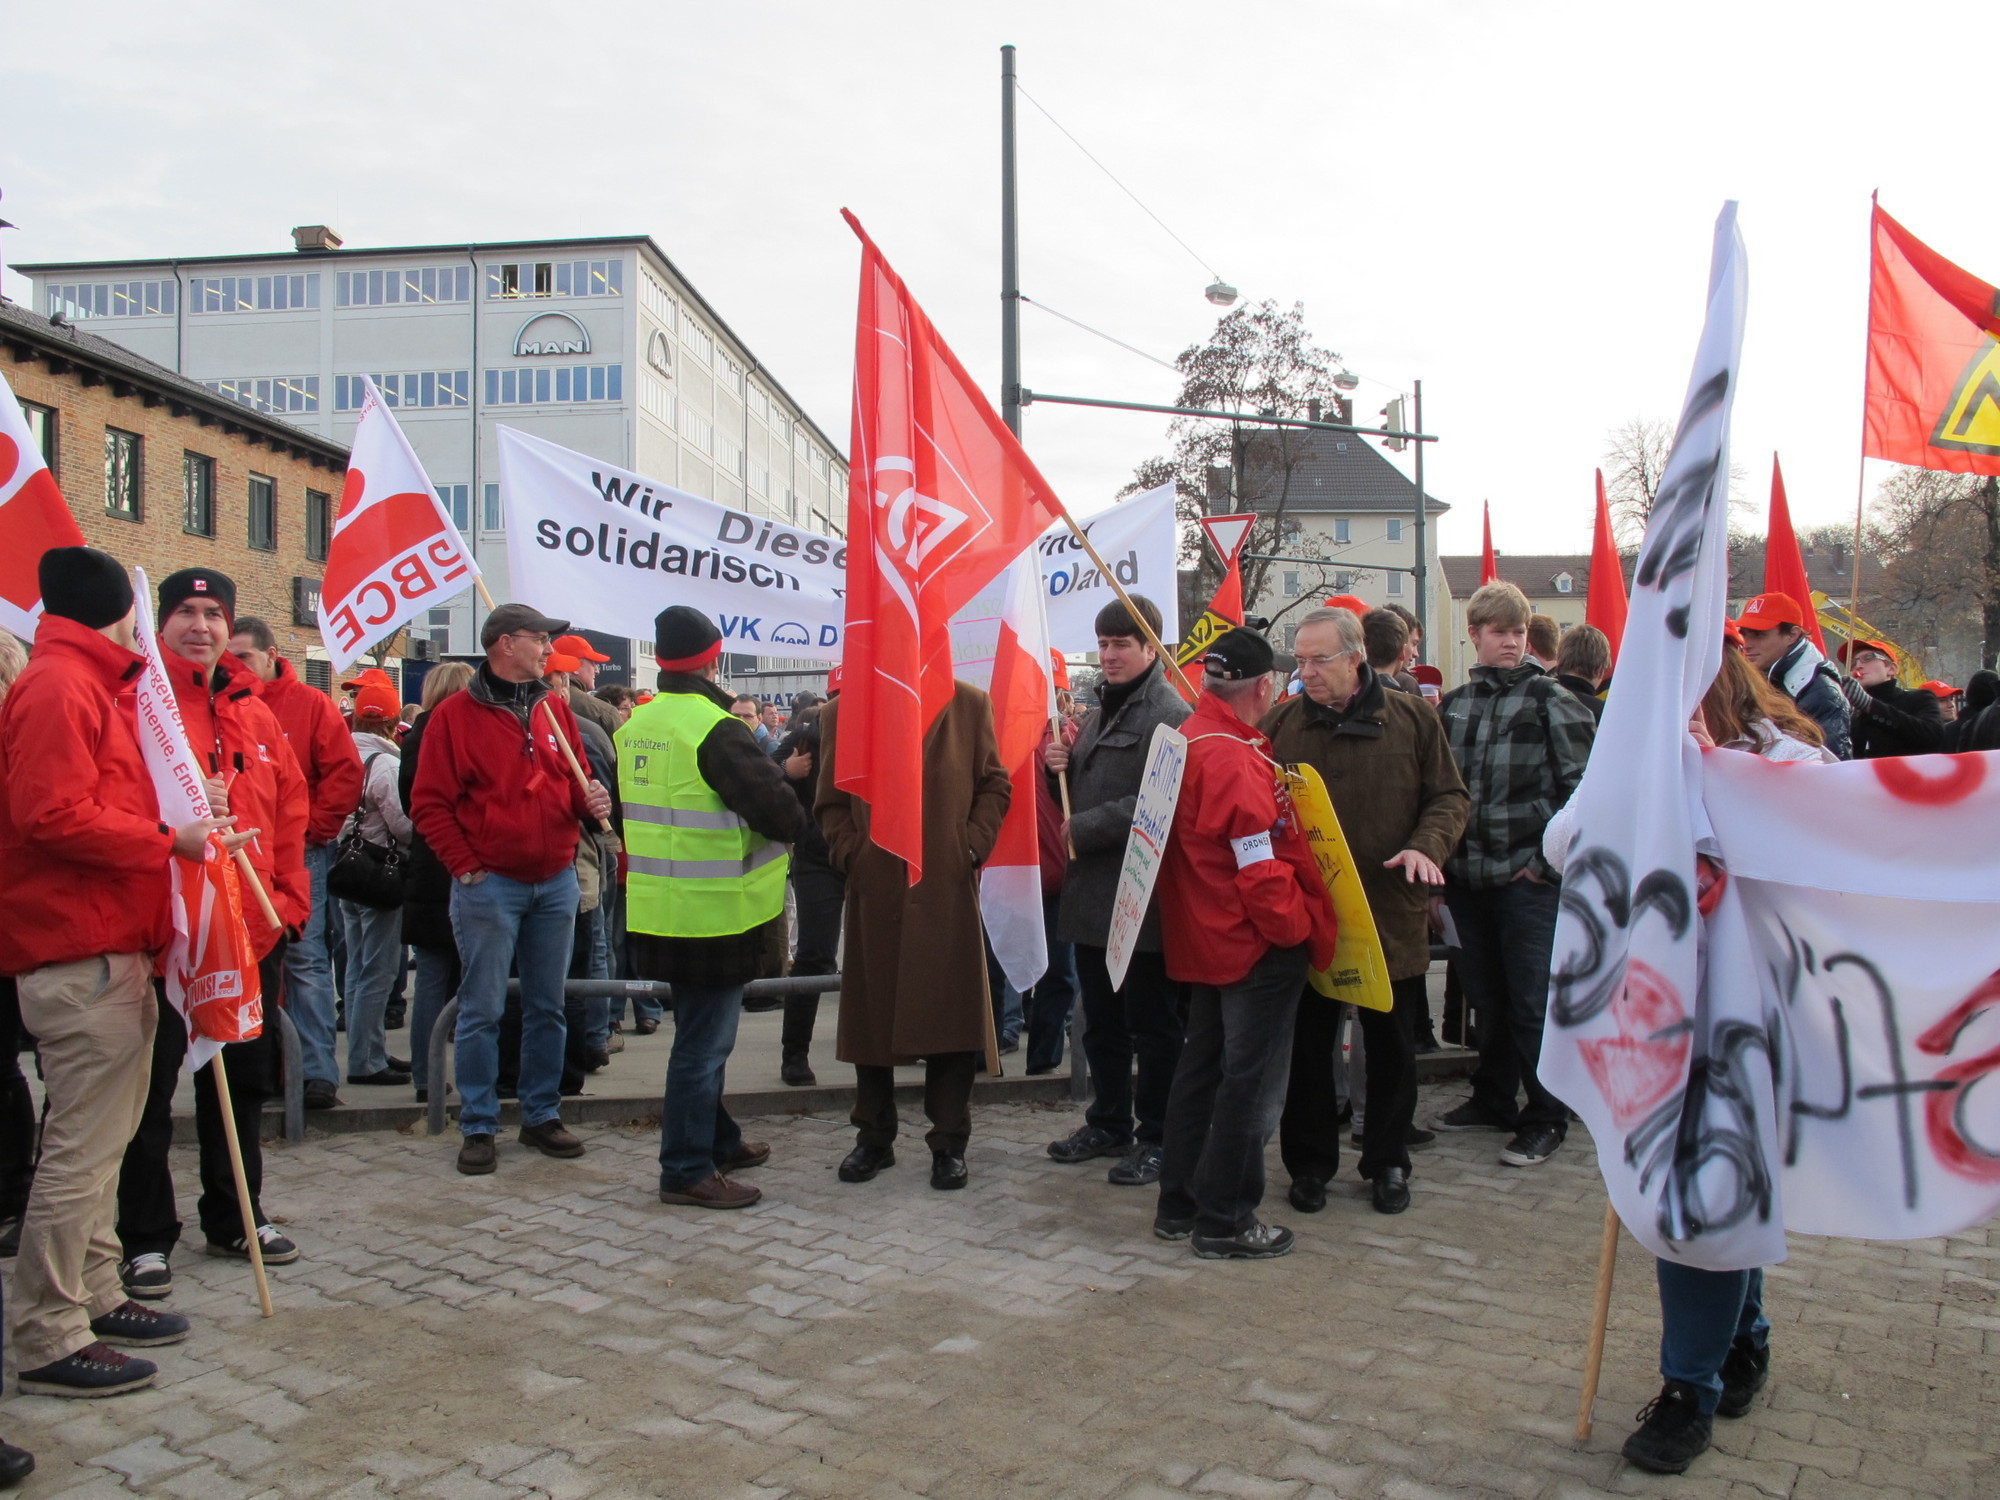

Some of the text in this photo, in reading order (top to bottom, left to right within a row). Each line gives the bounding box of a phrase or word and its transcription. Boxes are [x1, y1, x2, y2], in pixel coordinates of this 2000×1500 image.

[520, 341, 584, 356] MAN
[592, 471, 1096, 570] Wir Diese ind
[719, 614, 838, 647] VK MAN D
[139, 692, 176, 763] Chemie,
[633, 738, 669, 752] schützen!
